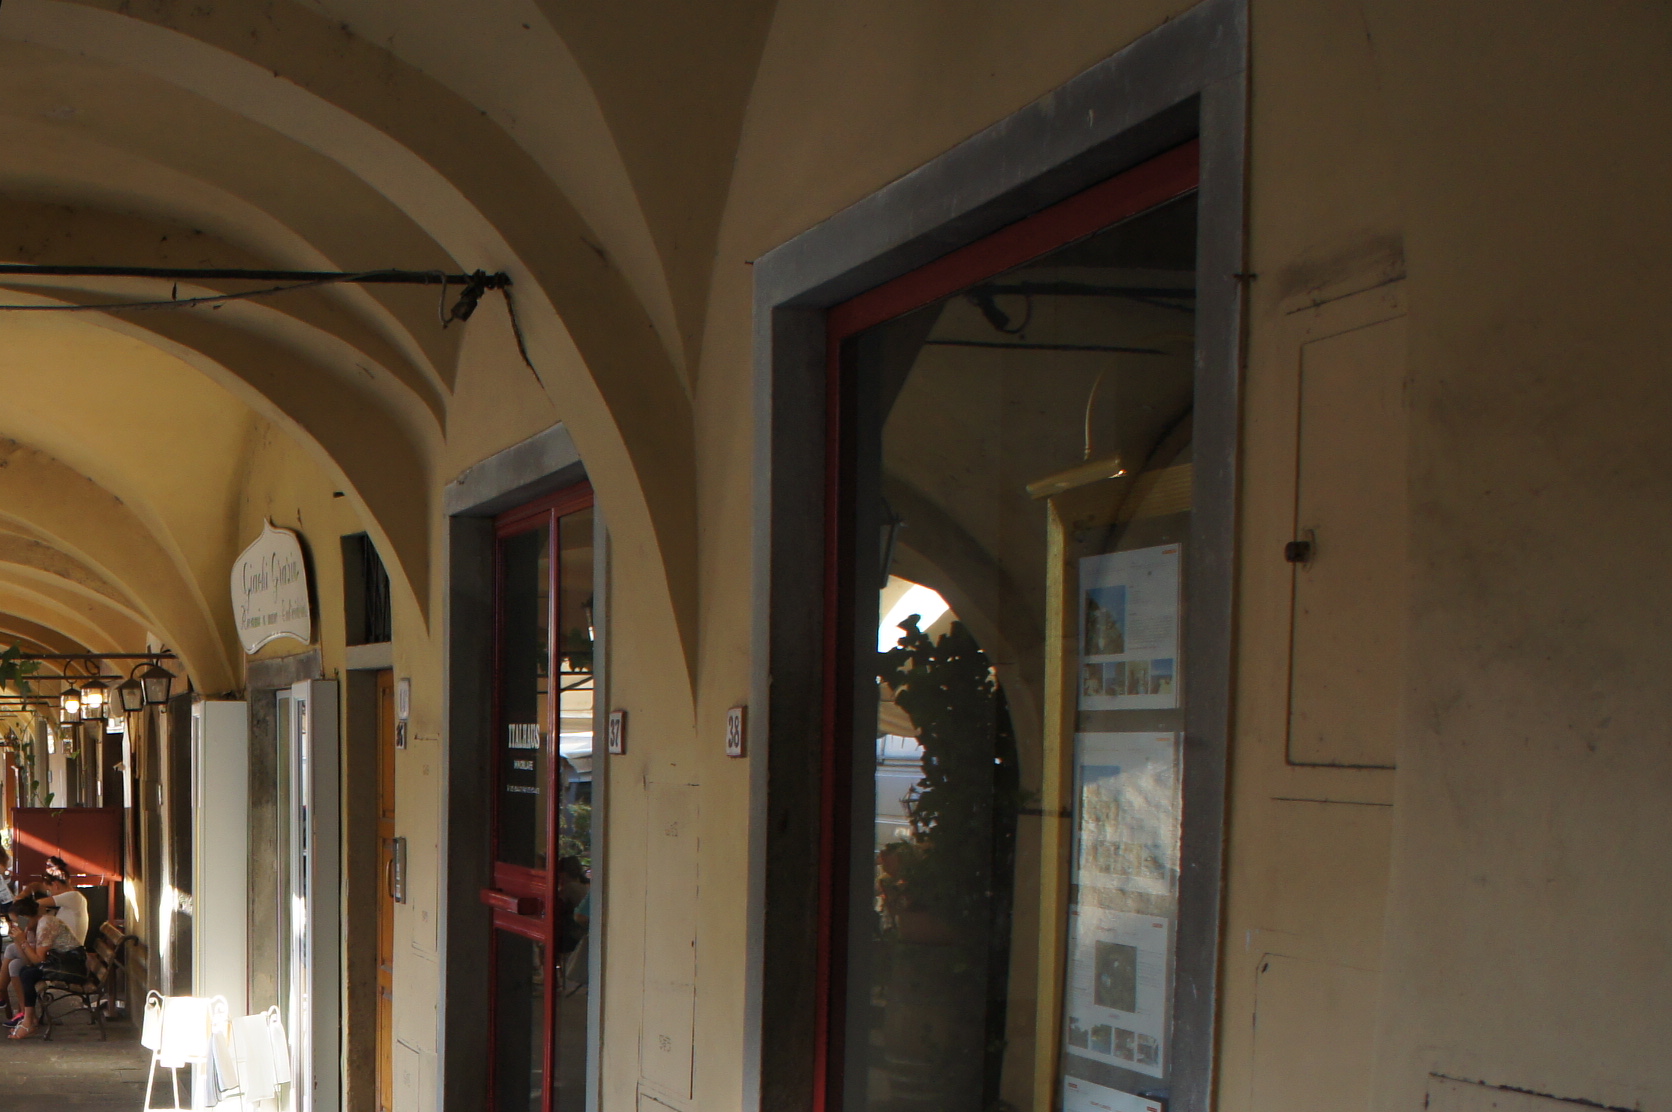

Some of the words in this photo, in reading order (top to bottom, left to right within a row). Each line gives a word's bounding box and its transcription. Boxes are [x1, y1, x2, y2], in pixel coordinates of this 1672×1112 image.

[508, 723, 540, 749] ITALHAUS
[610, 719, 620, 747] 37
[728, 716, 740, 748] 38
